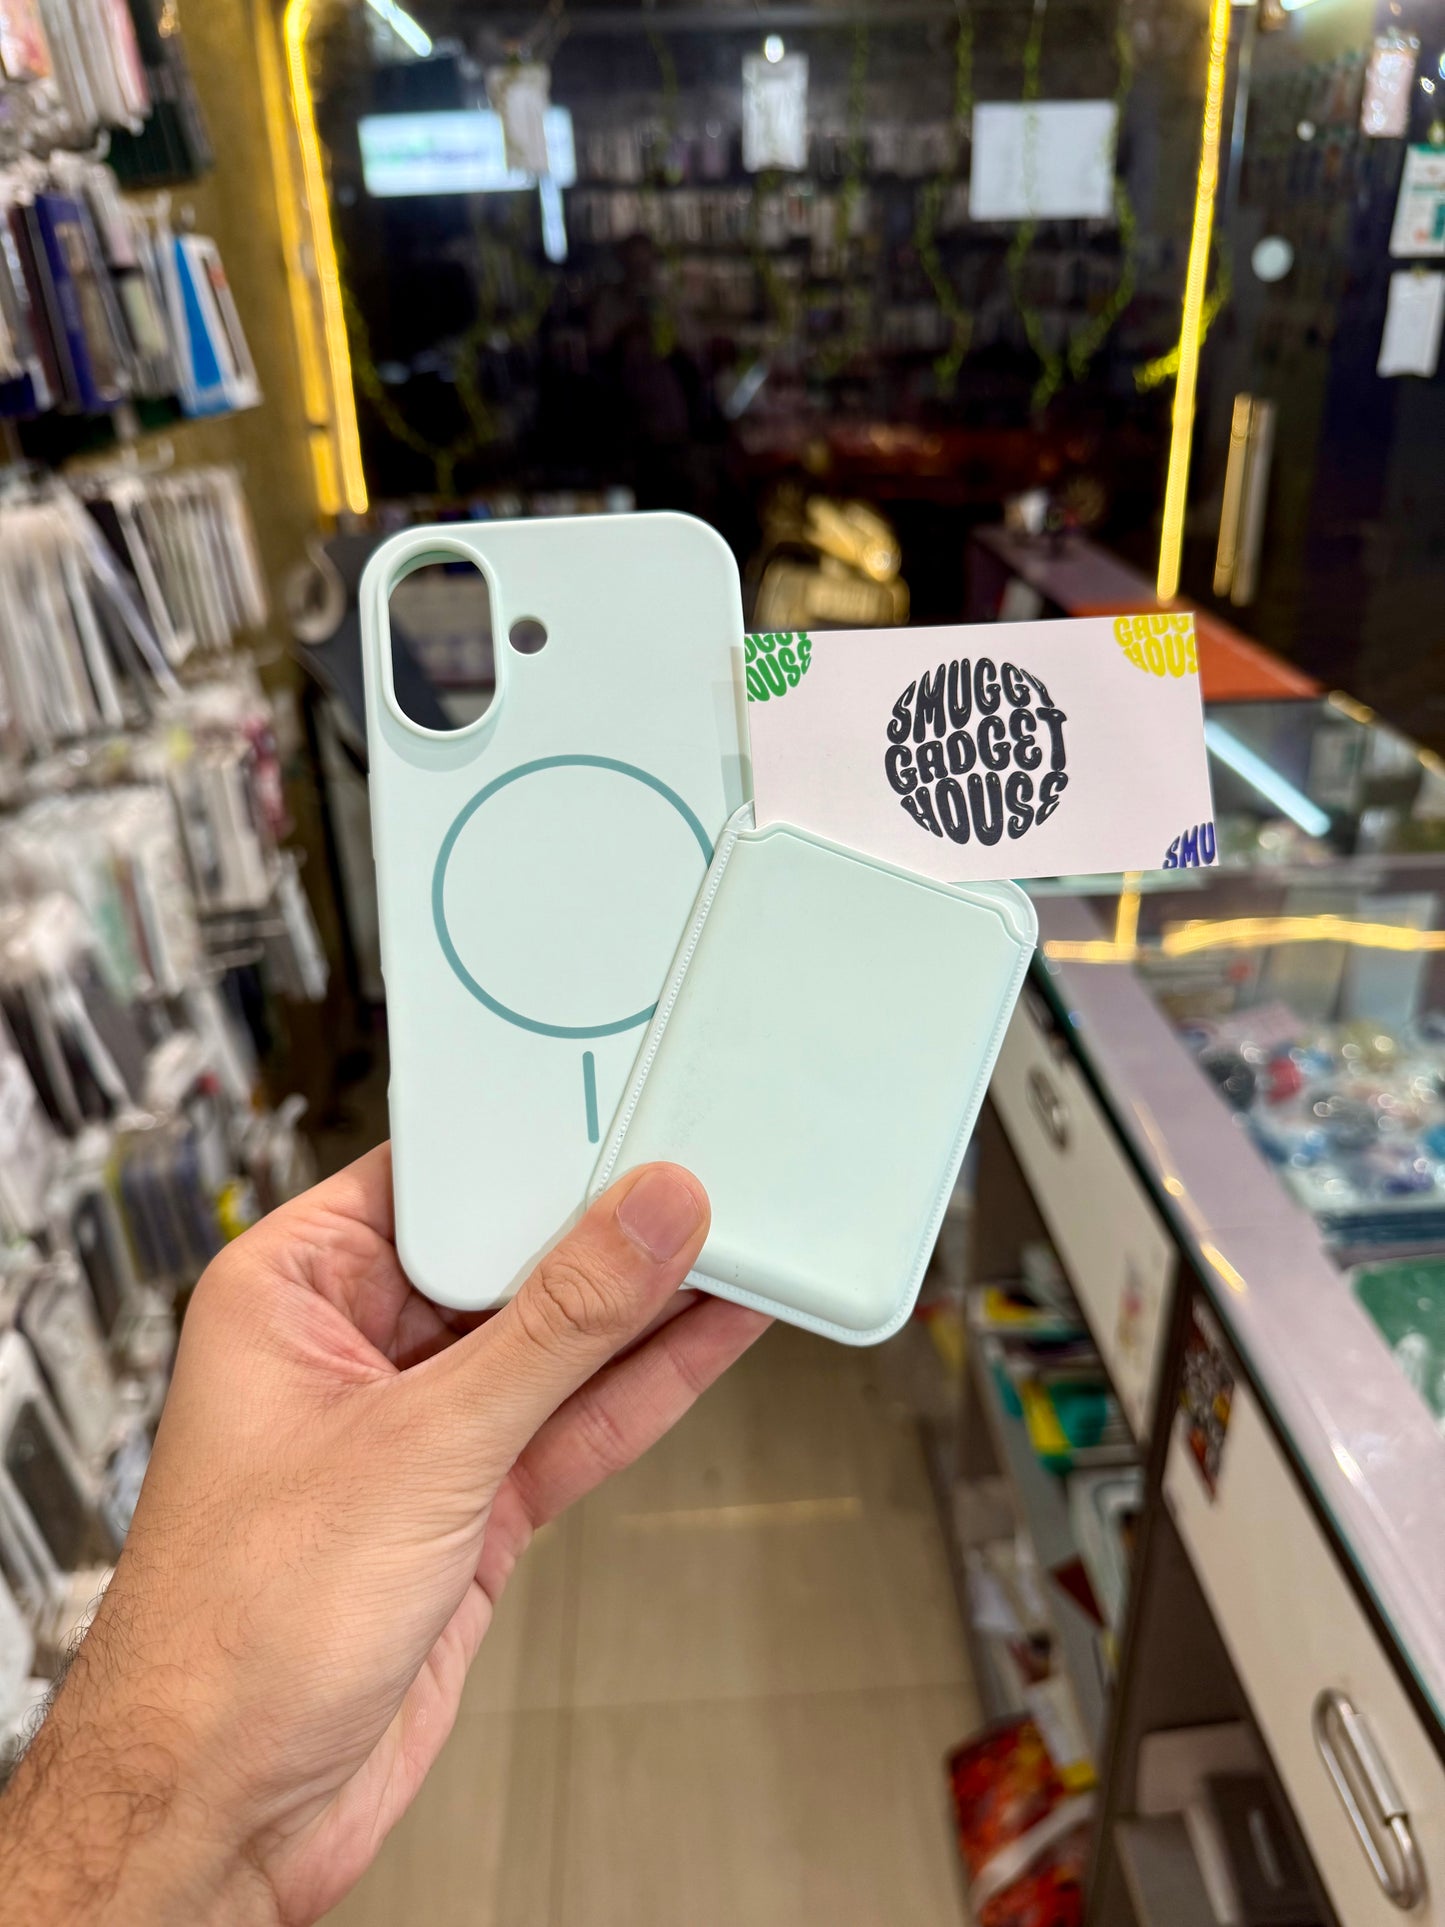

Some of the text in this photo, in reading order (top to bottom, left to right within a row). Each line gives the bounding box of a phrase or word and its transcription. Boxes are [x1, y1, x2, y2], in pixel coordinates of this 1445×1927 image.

[746, 639, 812, 702] OUSE
[887, 658, 1055, 744] SMUGGY
[885, 707, 1068, 795] GADGET
[900, 770, 1069, 846] HOUSE
[1162, 821, 1216, 870] SMU
